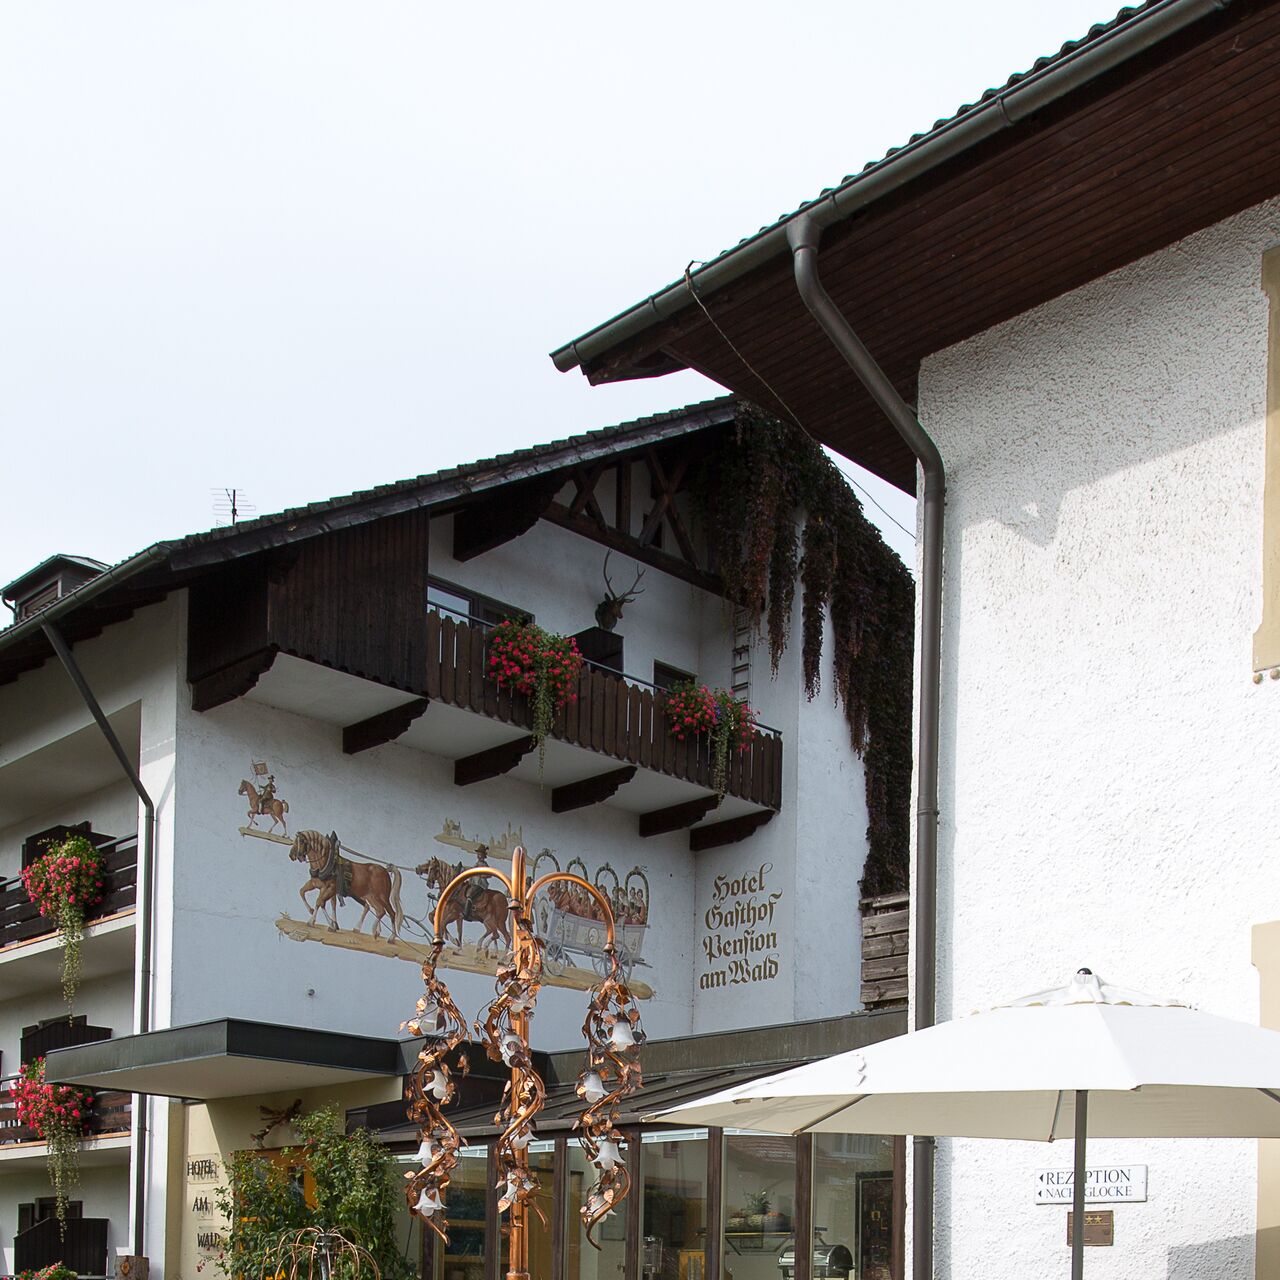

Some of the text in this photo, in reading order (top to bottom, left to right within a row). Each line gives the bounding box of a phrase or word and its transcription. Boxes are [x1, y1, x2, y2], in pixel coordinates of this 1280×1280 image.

[713, 863, 773, 899] Hotel
[699, 953, 780, 990] am Wald
[187, 1159, 214, 1177] HOTEL
[1046, 1169, 1131, 1185] REZPTION
[192, 1196, 208, 1212] AM
